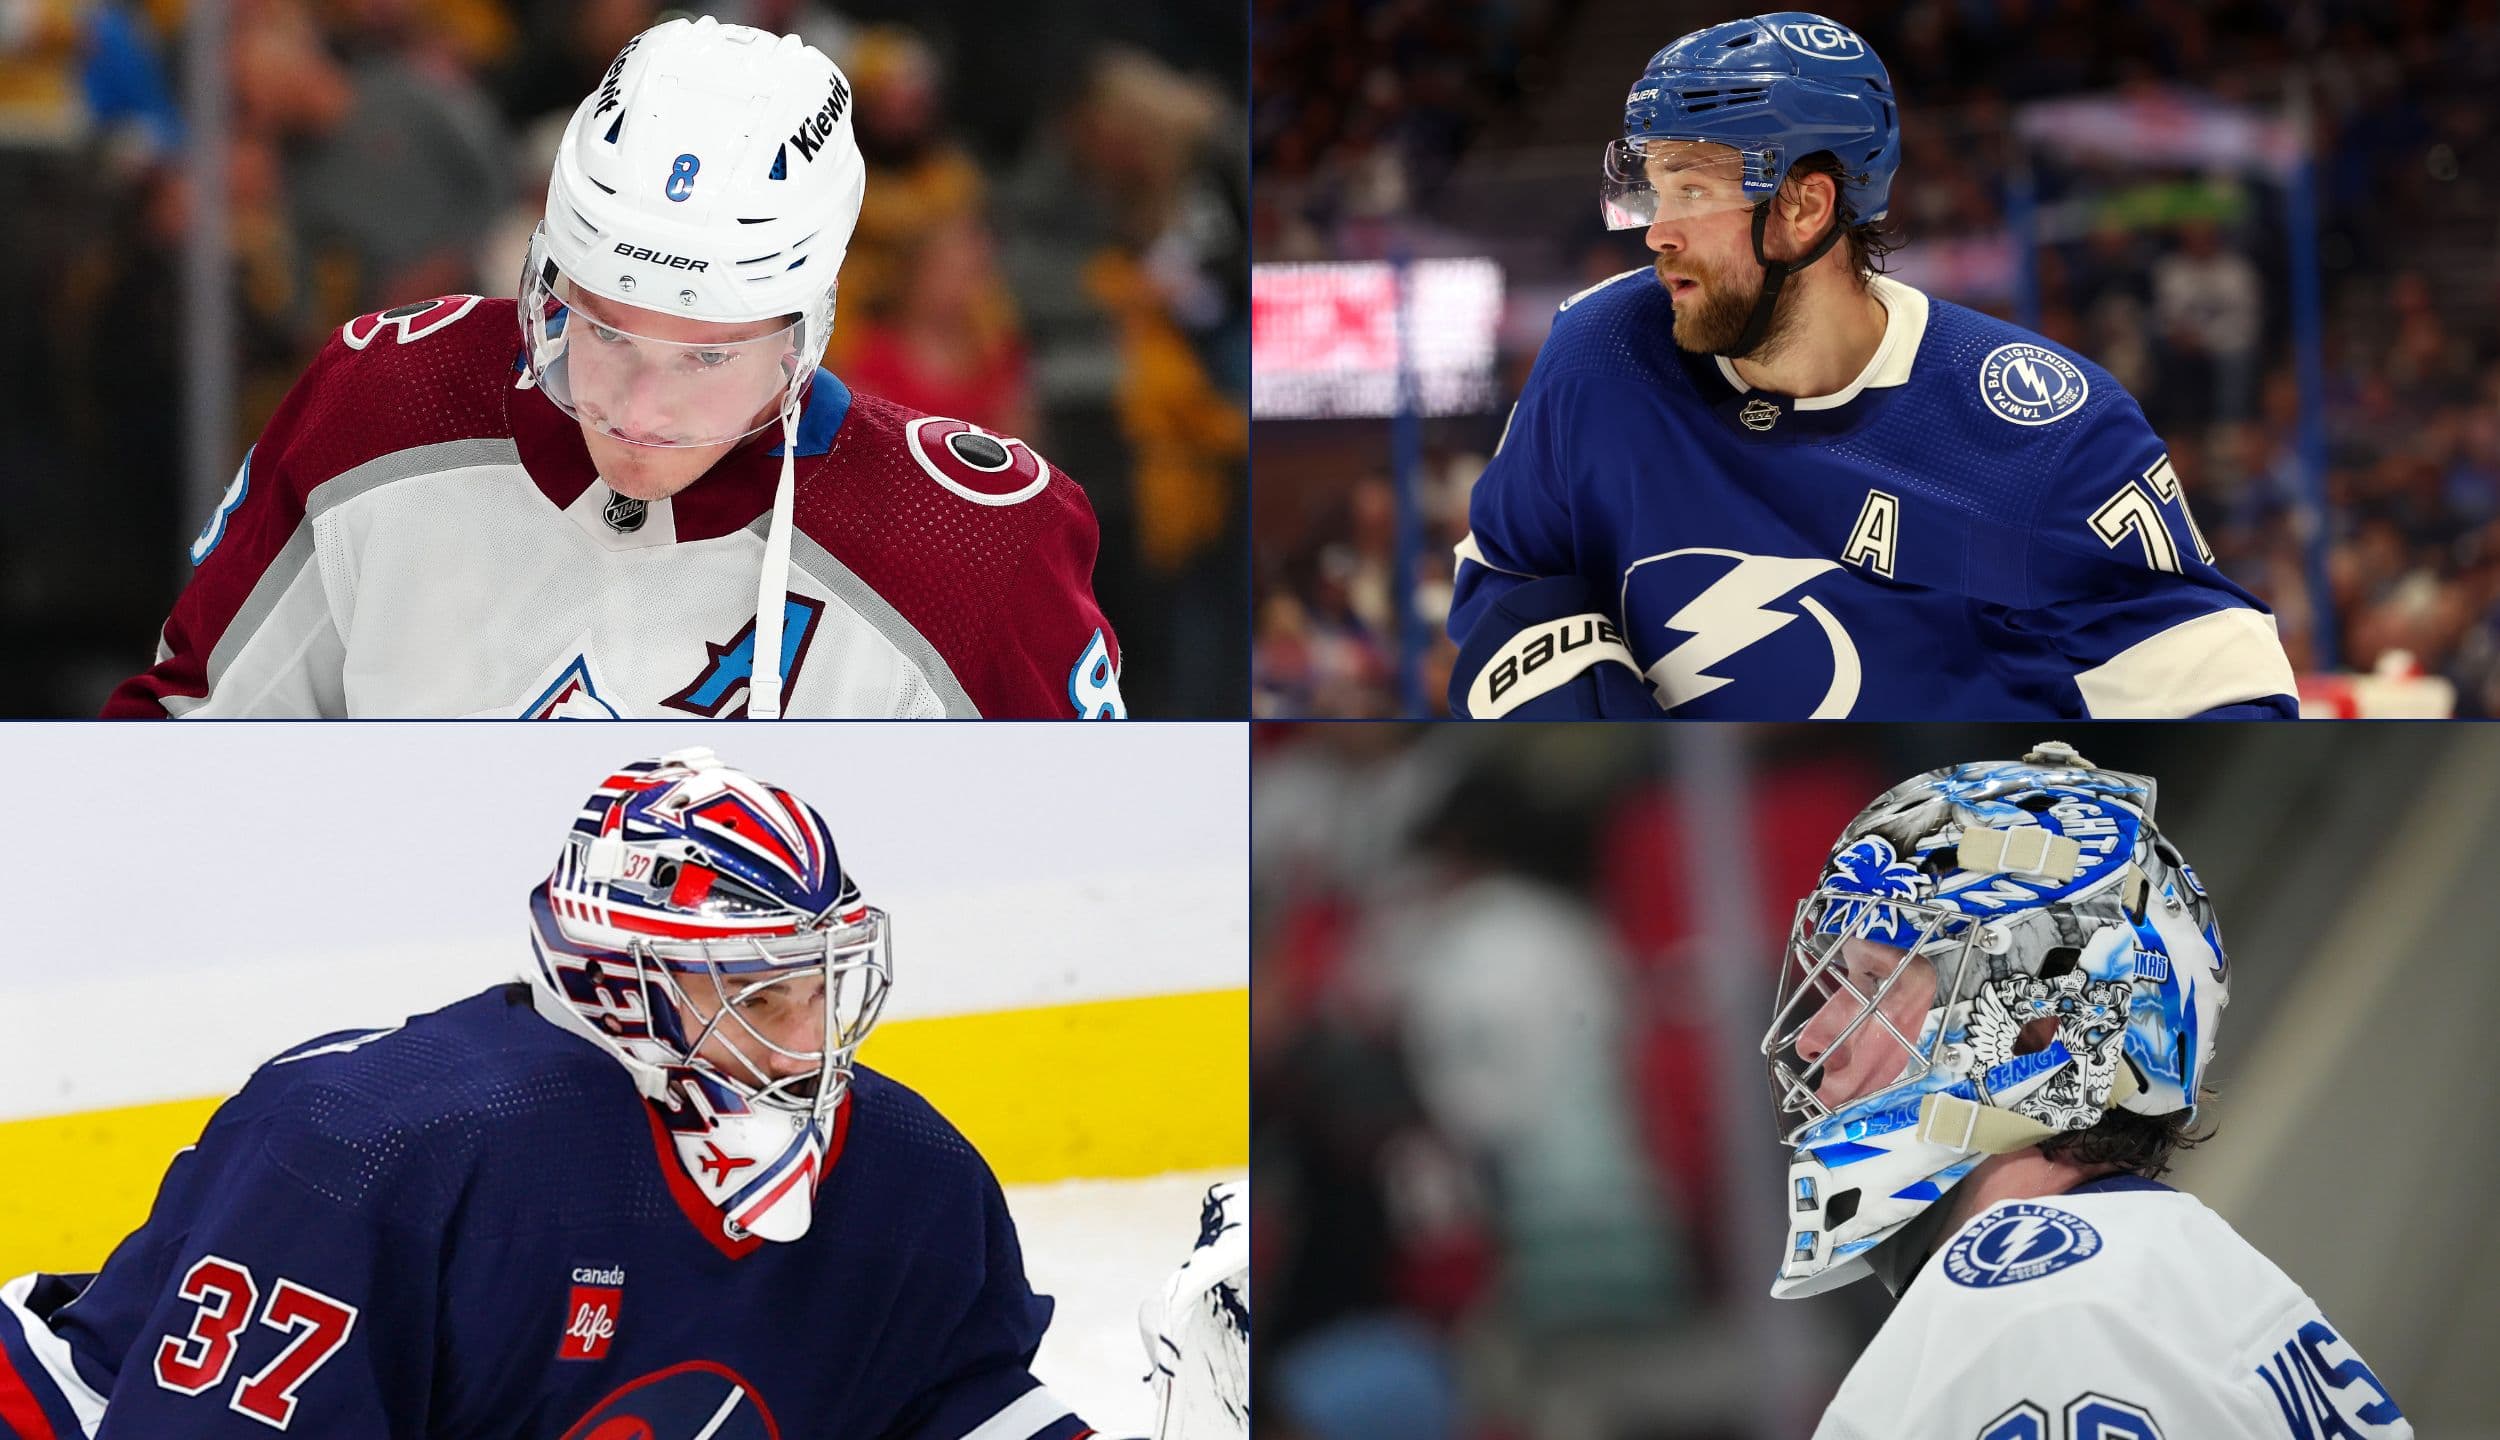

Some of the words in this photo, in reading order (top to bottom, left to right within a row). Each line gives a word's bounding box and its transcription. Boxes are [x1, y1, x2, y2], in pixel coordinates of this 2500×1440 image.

[1788, 24, 1863, 51] TGH
[593, 37, 641, 120] iewit
[789, 72, 850, 163] Kiewit
[665, 153, 700, 202] 8
[1988, 361, 2001, 389] BAY
[1998, 347, 2077, 379] LIGHTNING
[1993, 391, 2041, 418] TAMPA
[1841, 488, 1898, 580] A
[2086, 452, 2215, 575] 77
[623, 854, 651, 880] 37
[571, 1264, 625, 1286] canada
[153, 1254, 358, 1431] 37
[565, 1302, 616, 1353] life
